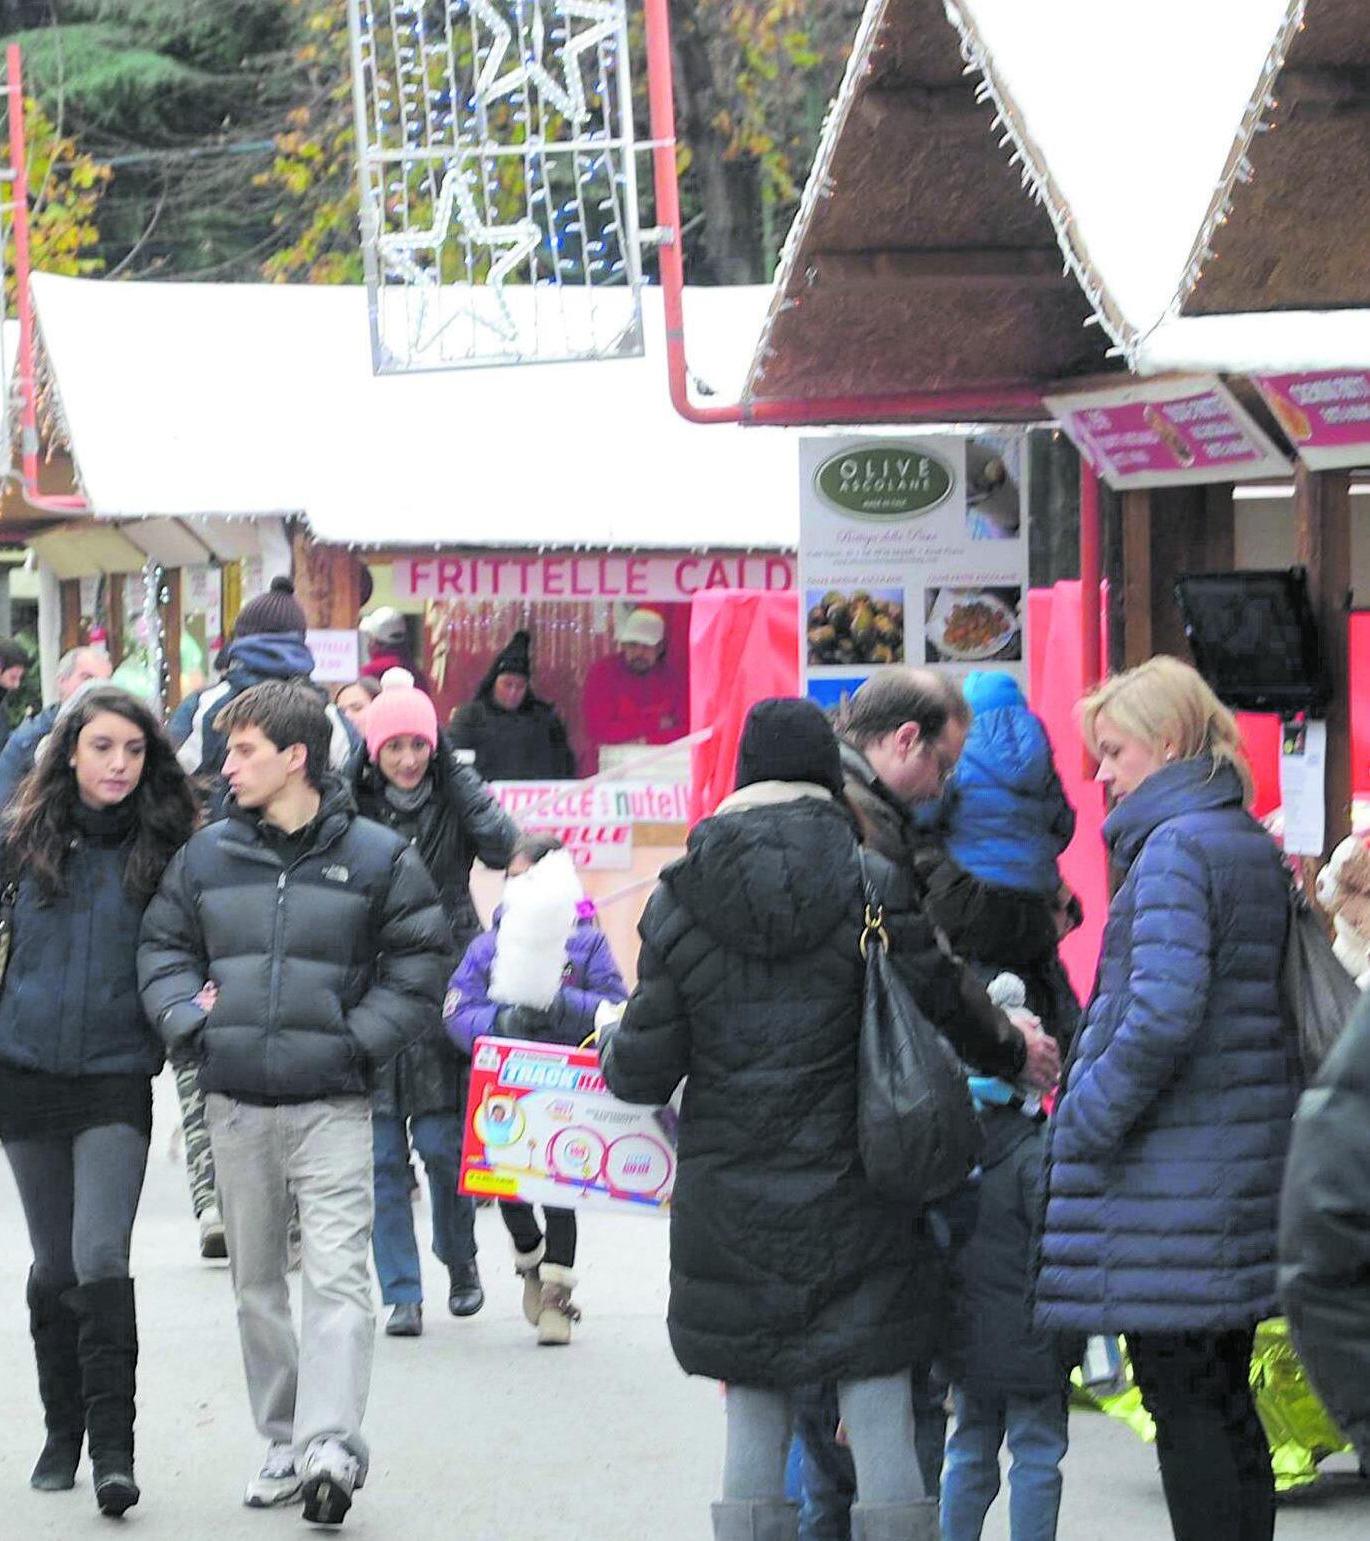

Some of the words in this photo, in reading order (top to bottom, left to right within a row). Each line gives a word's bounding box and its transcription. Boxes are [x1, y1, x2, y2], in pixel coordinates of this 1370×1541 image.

[839, 458, 930, 480] OLIVE
[838, 479, 930, 494] ASCOLANE
[409, 557, 649, 594] FRITTELLE
[675, 555, 793, 594] CALD
[615, 783, 692, 819] nutell
